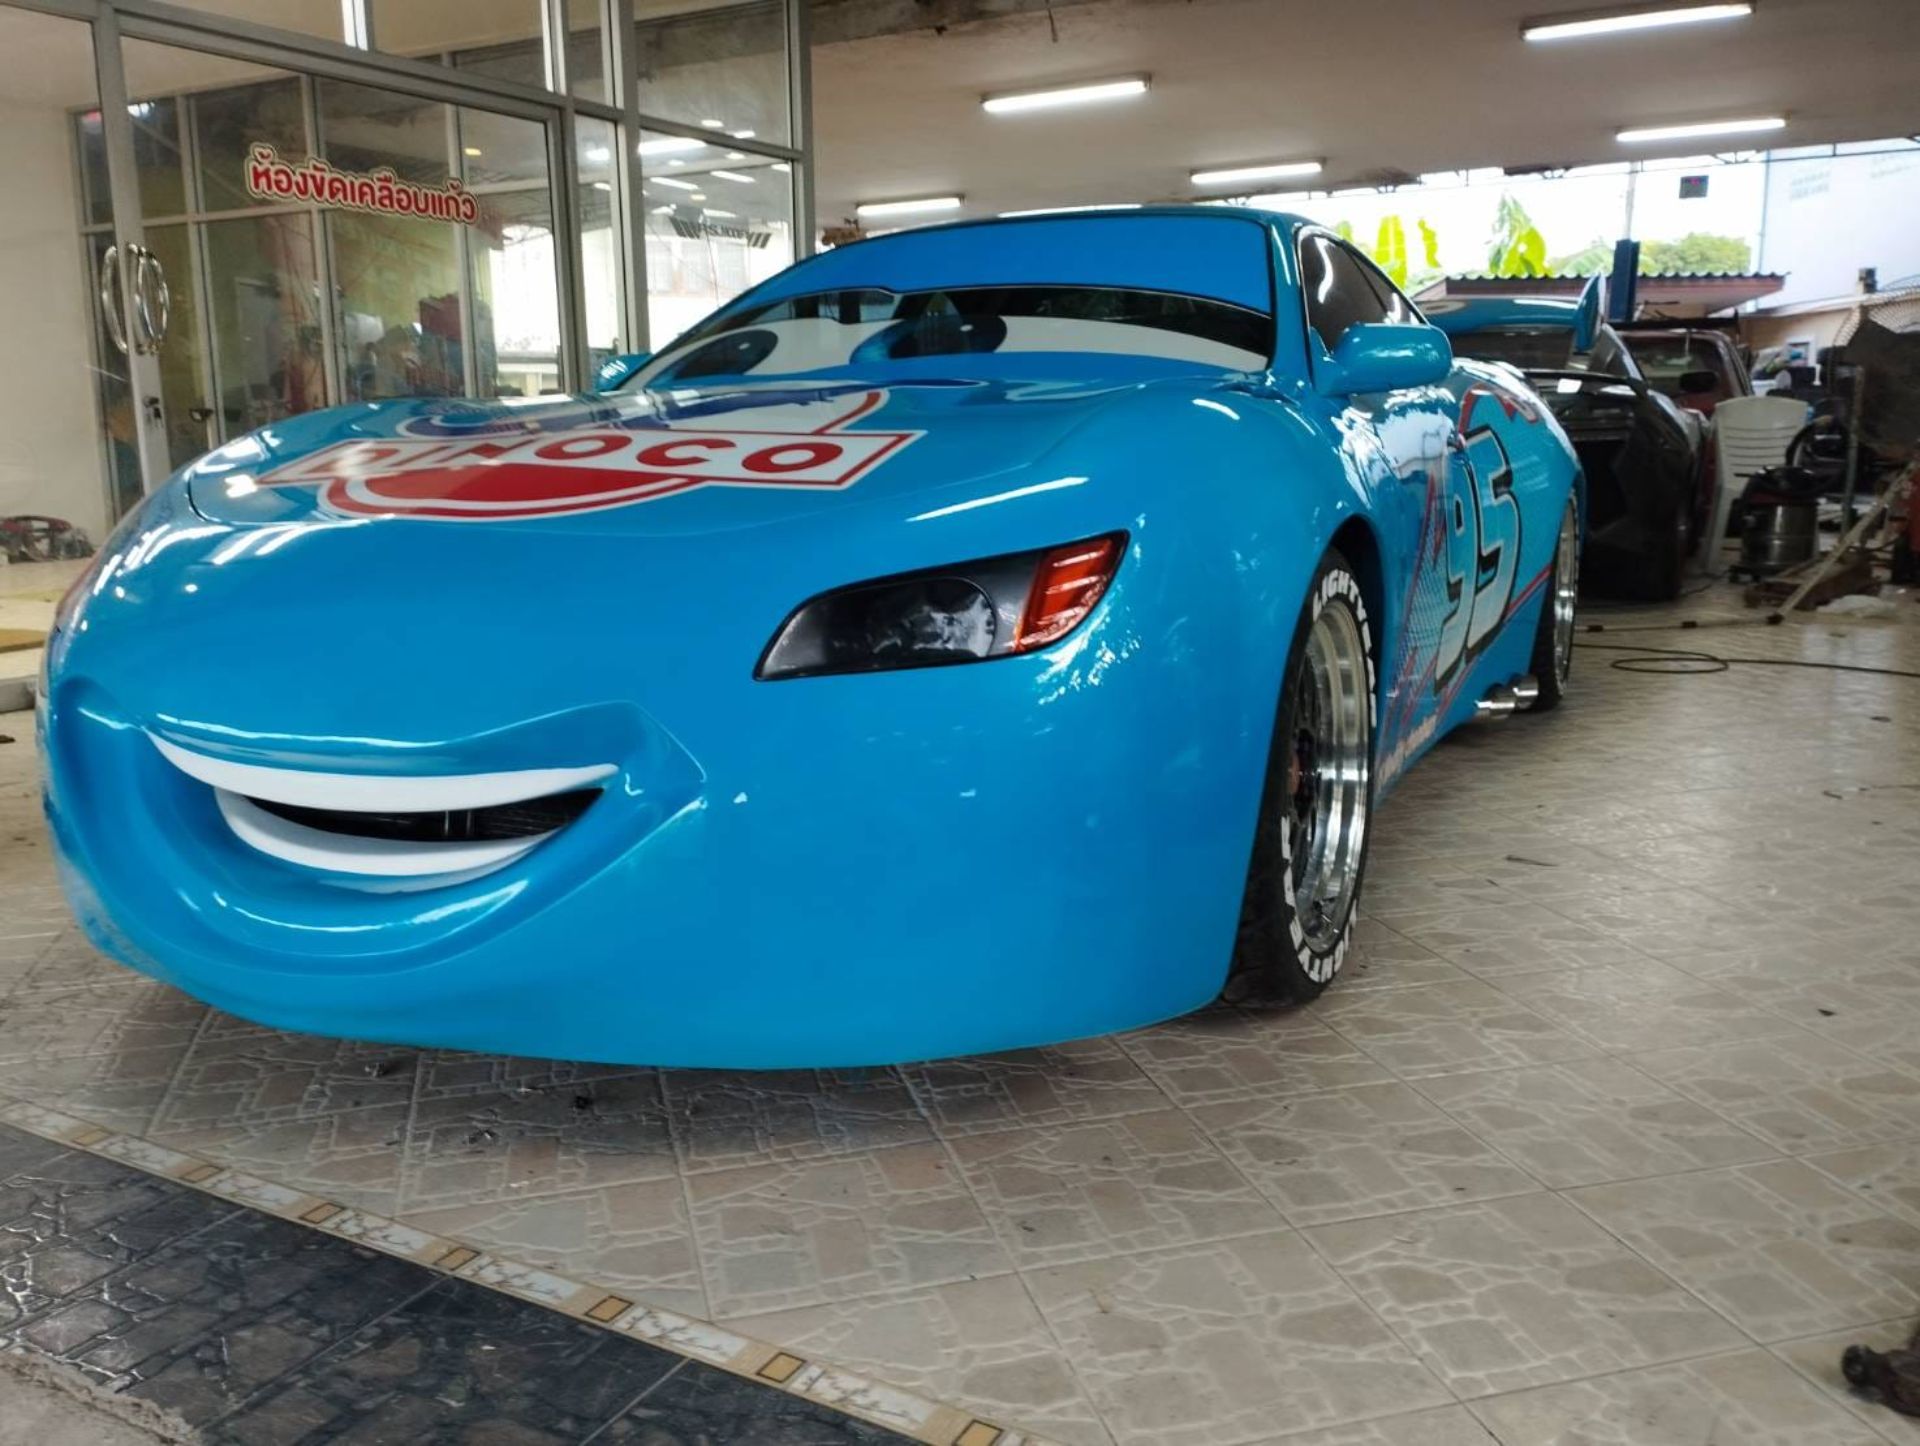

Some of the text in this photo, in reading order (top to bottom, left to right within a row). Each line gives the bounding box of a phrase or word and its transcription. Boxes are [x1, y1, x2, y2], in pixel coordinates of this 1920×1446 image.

[248, 147, 479, 222] ห้องขัดเคลือบแก้ว
[1433, 424, 1522, 694] 95
